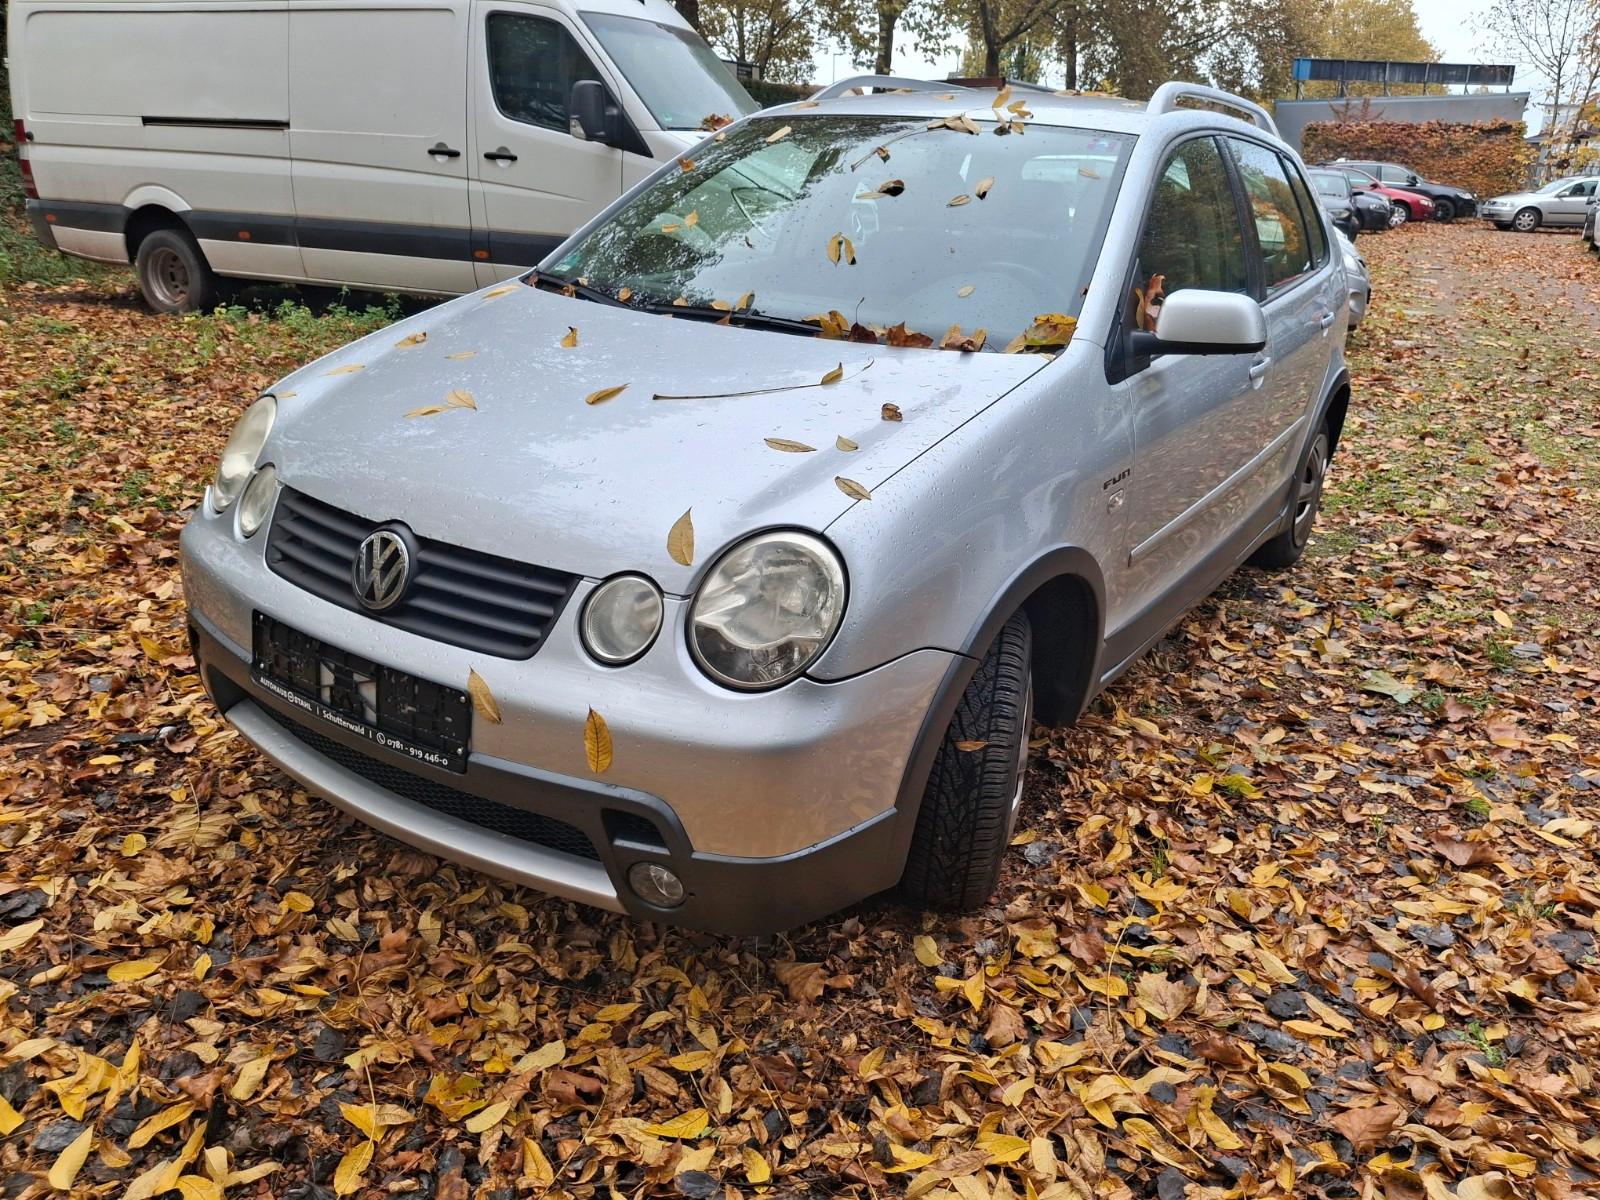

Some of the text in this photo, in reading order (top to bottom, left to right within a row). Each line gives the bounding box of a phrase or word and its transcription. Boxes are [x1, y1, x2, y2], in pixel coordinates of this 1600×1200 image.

[353, 531, 409, 609] VW
[260, 676, 313, 711] AUTOHAUS STAHL
[322, 710, 365, 735] Schutterwald
[387, 739, 404, 751] 0781
[409, 747, 423, 759] 919
[424, 752, 448, 766] 446-0
